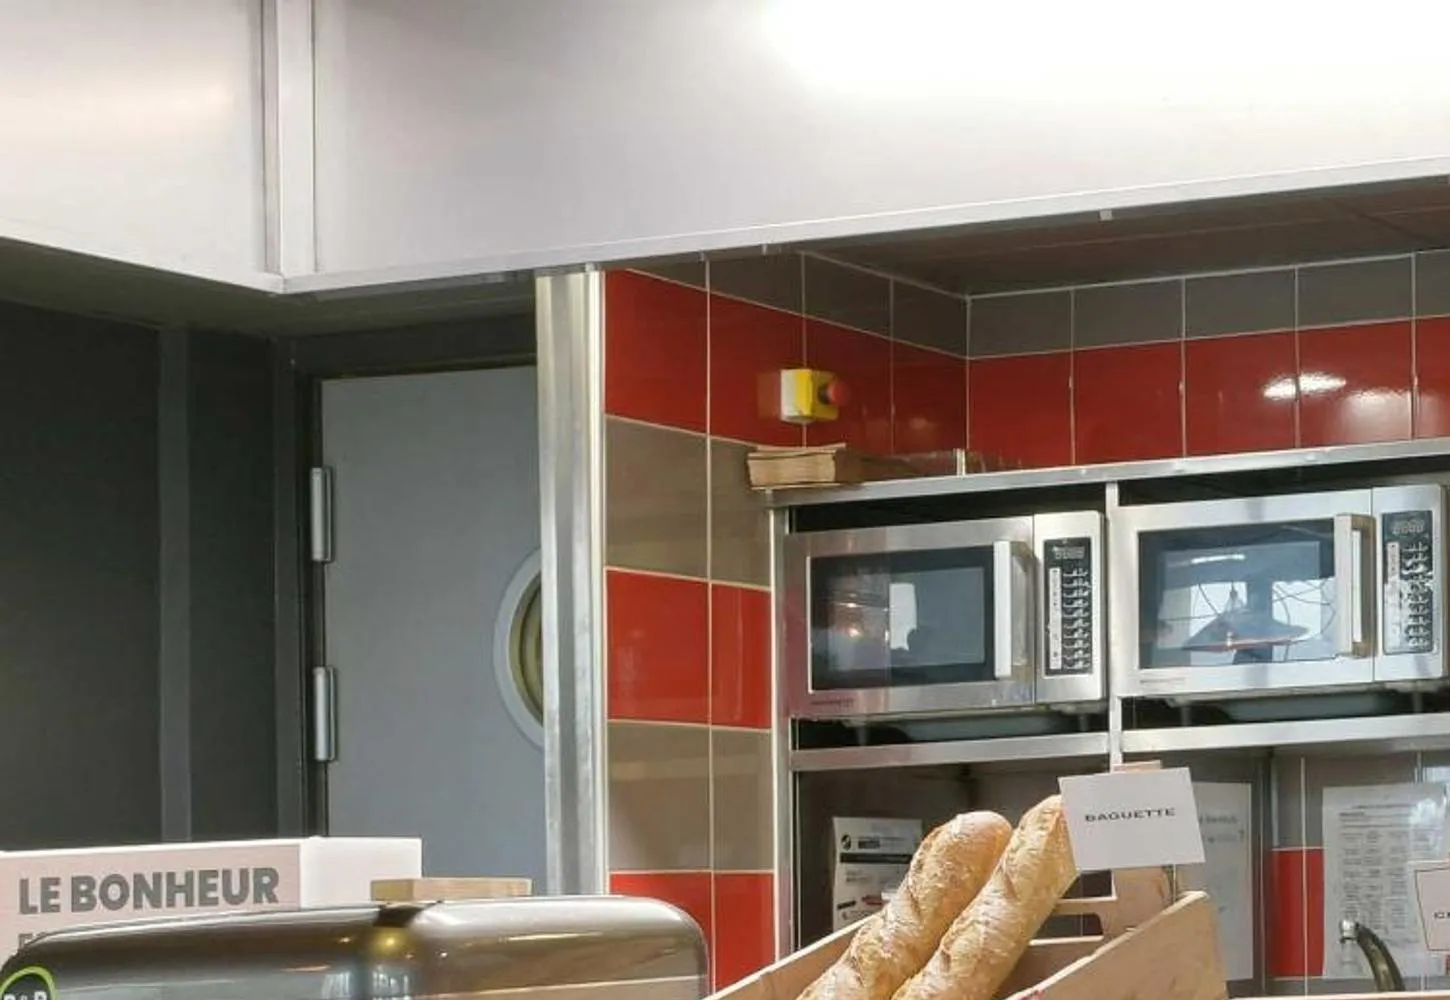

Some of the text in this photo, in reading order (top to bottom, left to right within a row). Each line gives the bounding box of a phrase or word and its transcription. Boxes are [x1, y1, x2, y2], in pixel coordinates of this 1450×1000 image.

[1085, 807, 1176, 822] BAGUETTE
[19, 867, 279, 915] LE BONHEUR
